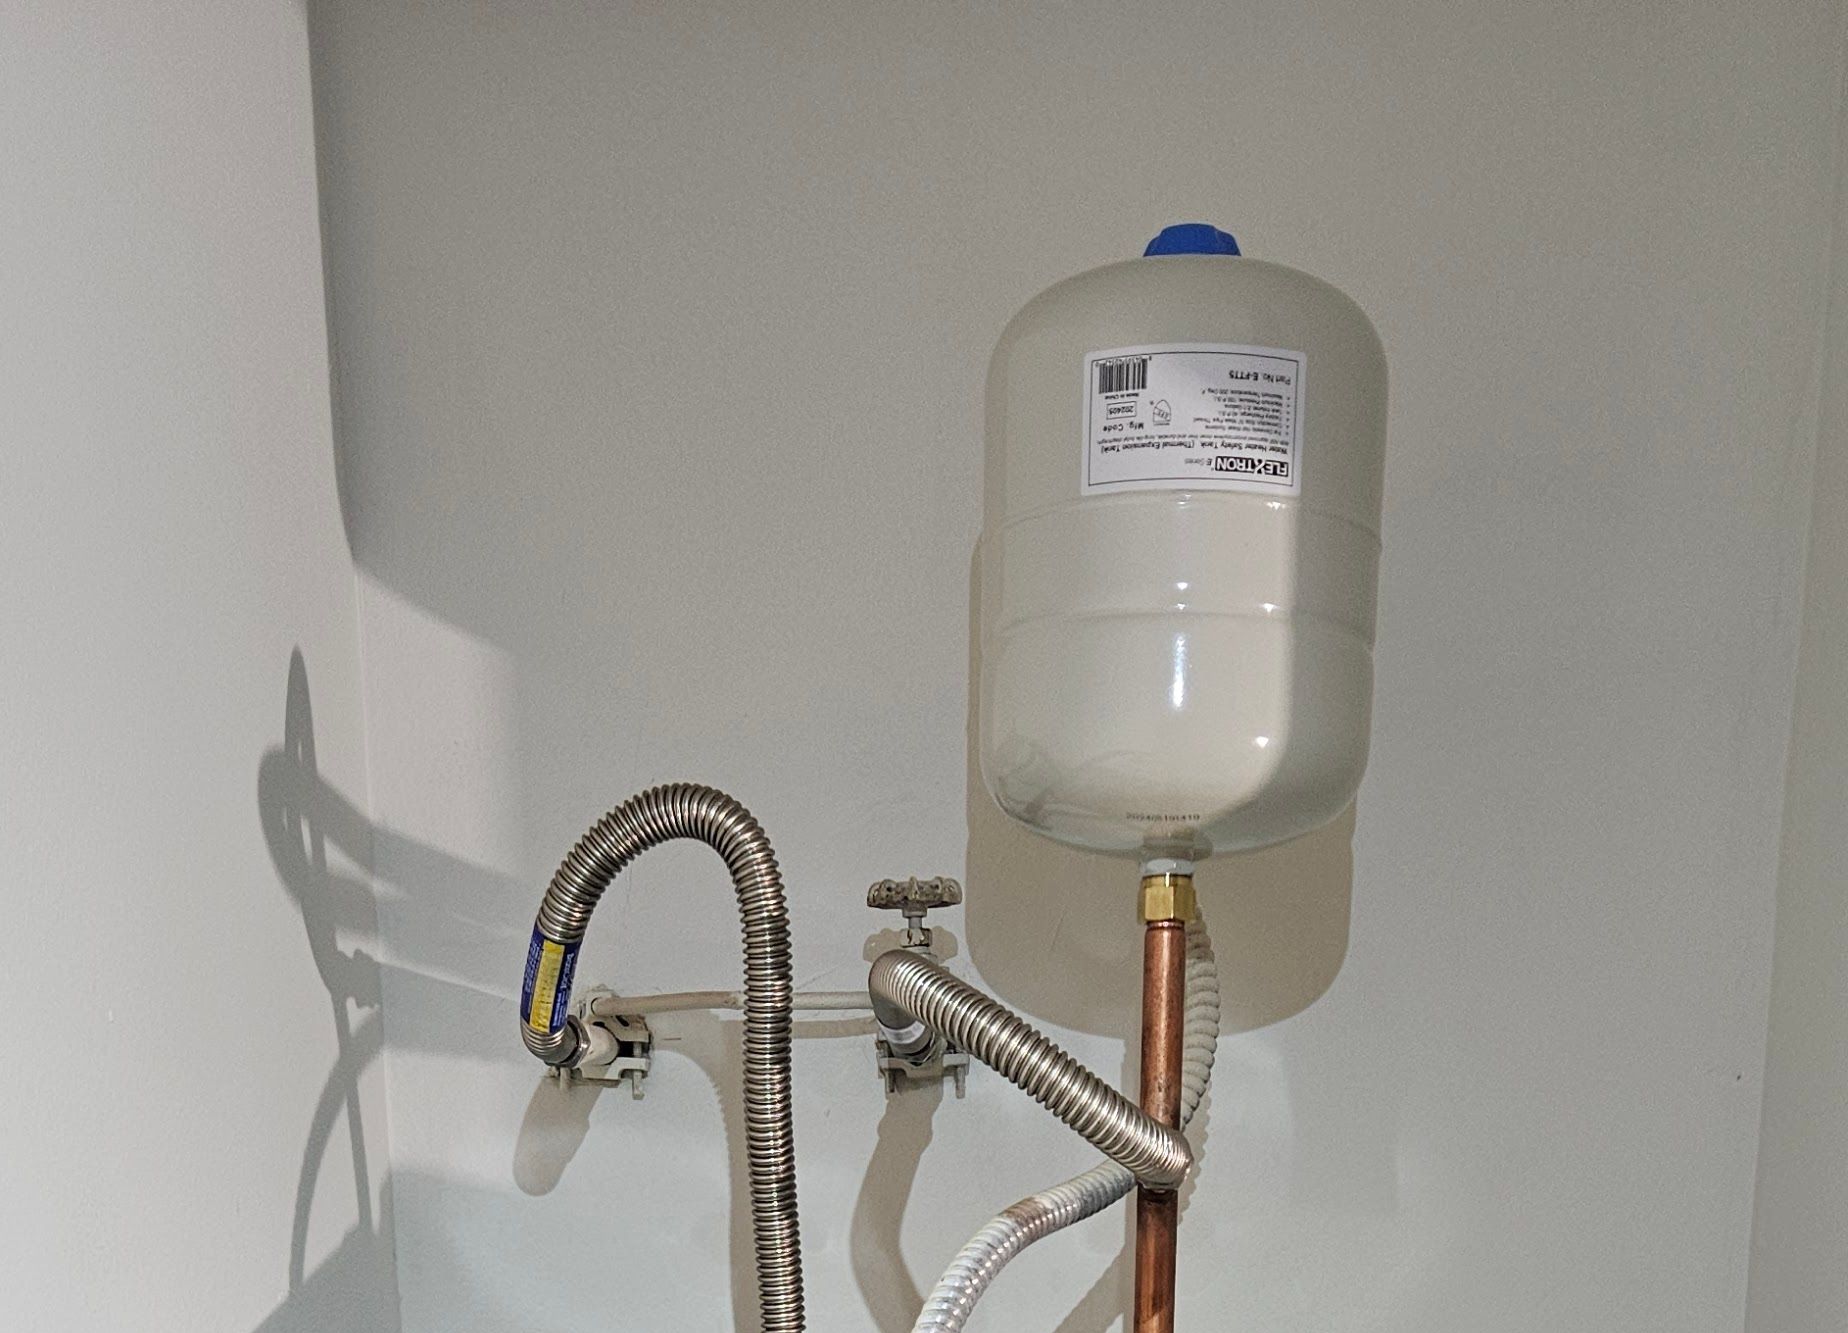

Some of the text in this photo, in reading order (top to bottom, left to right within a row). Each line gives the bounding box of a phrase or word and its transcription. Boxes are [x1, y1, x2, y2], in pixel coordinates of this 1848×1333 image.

[1103, 423, 1125, 433] Code
[1123, 441, 1161, 450] Expansion
[1221, 441, 1243, 450] Safety
[1245, 443, 1268, 452] Heater
[1269, 447, 1289, 455] Water
[1216, 456, 1290, 478] FLEXTRON
